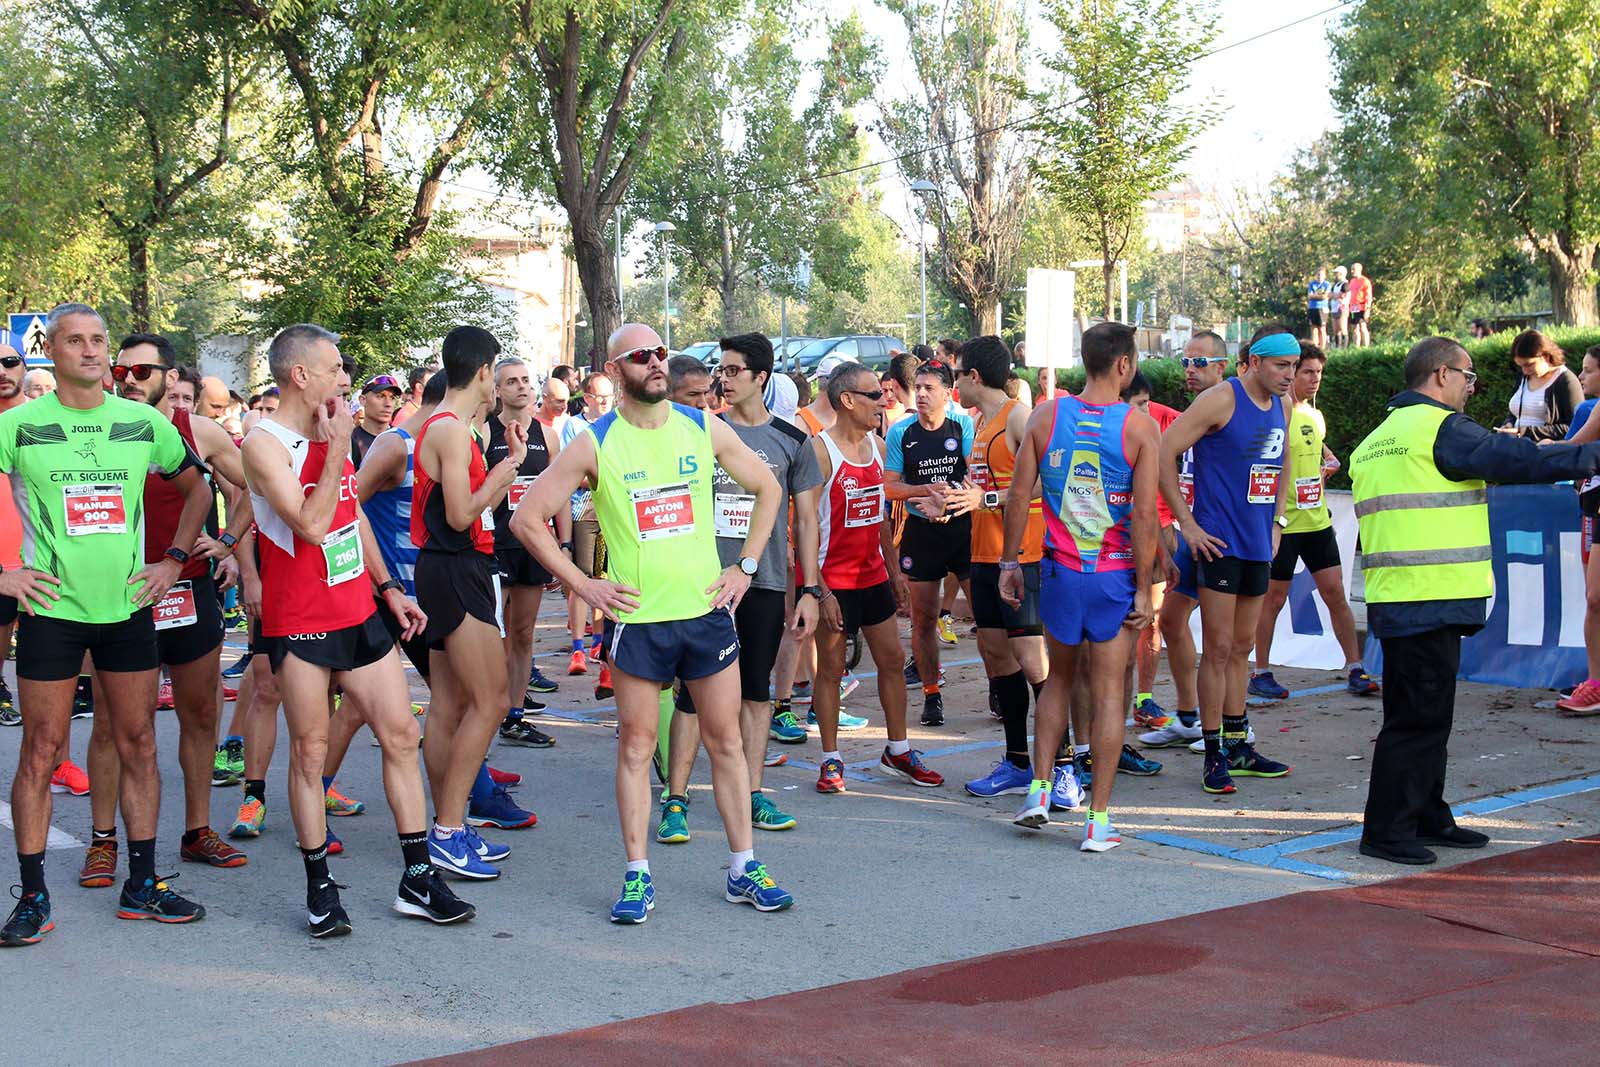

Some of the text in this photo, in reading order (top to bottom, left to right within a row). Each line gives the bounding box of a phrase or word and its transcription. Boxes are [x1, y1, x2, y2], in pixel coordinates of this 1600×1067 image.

[1385, 447, 1409, 457] NARGY
[679, 455, 698, 475] LS
[918, 455, 959, 468] saturday
[918, 465, 954, 476] running
[50, 471, 129, 482] C.M. SIGUEME
[623, 471, 647, 481] KNLTS
[930, 475, 948, 483] day
[1068, 486, 1091, 496] MGS
[1259, 485, 1271, 493] 714
[74, 501, 118, 511] MANUEL
[644, 501, 684, 516] ANTONI
[84, 511, 109, 521] 900
[858, 508, 871, 517] 271
[653, 513, 678, 525] 649
[729, 518, 748, 527] 1171
[158, 606, 180, 617] 765
